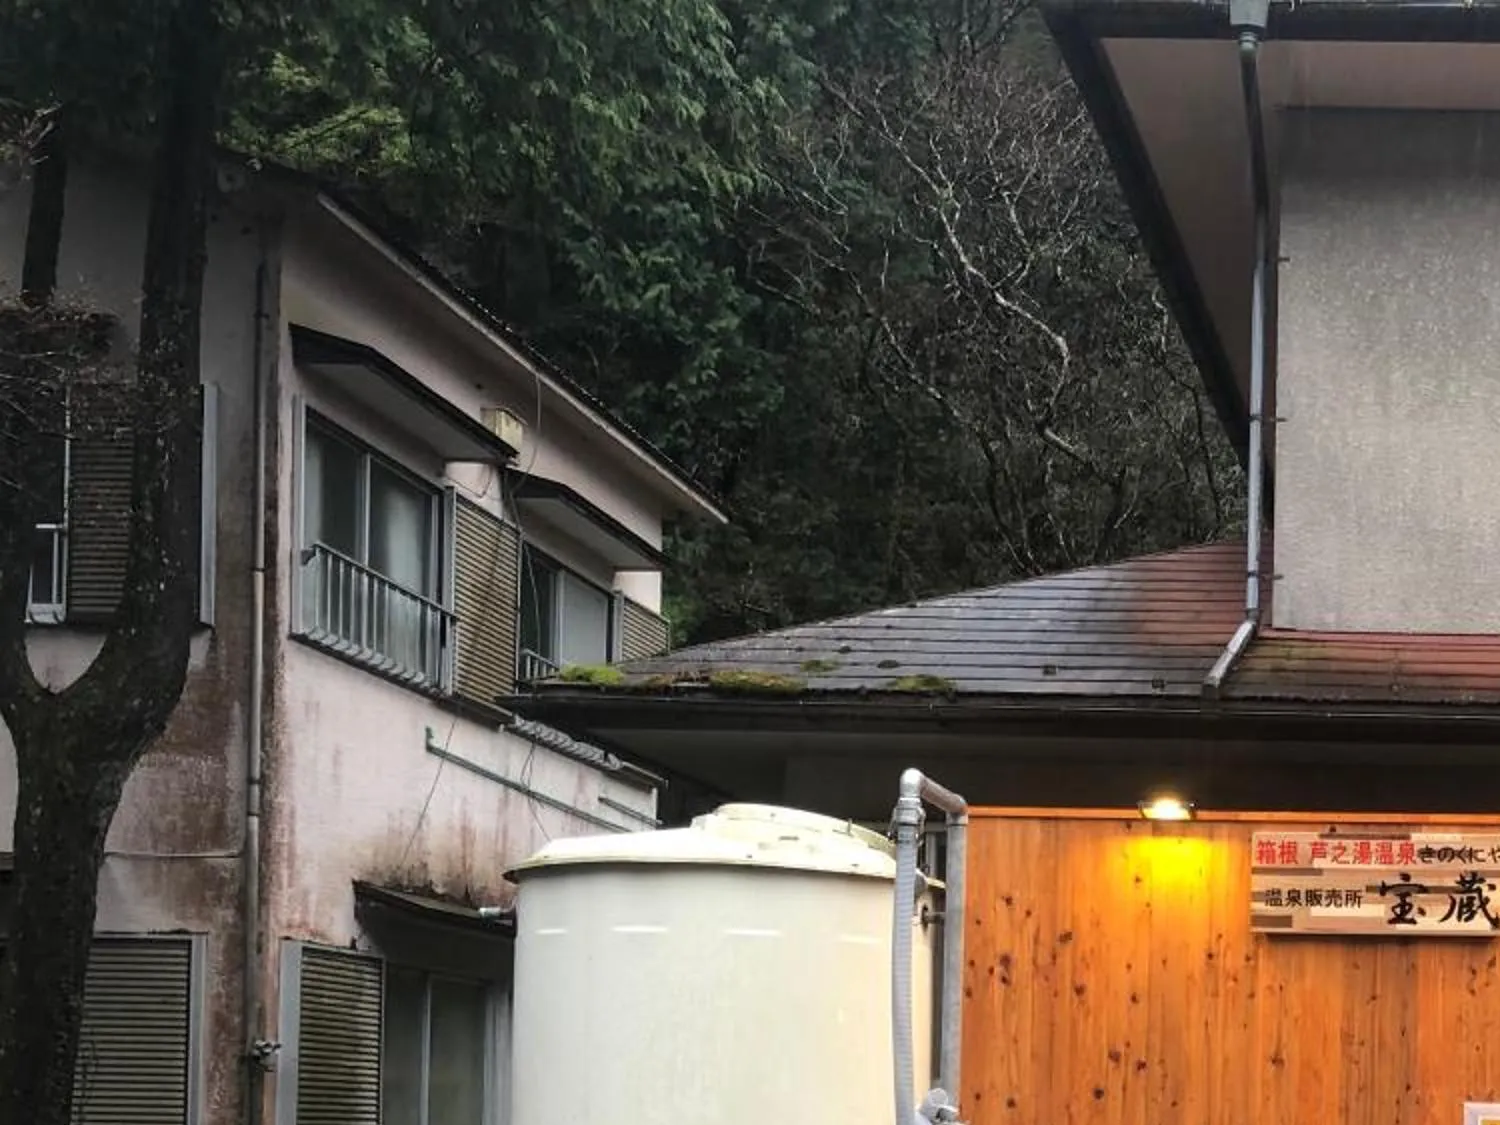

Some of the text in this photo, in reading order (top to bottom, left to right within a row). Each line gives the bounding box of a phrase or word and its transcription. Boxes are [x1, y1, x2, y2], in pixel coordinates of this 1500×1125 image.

[1256, 840, 1299, 865] 箱根
[1310, 840, 1417, 865] 芦之湯温泉
[1264, 888, 1363, 908] 温泉販売所
